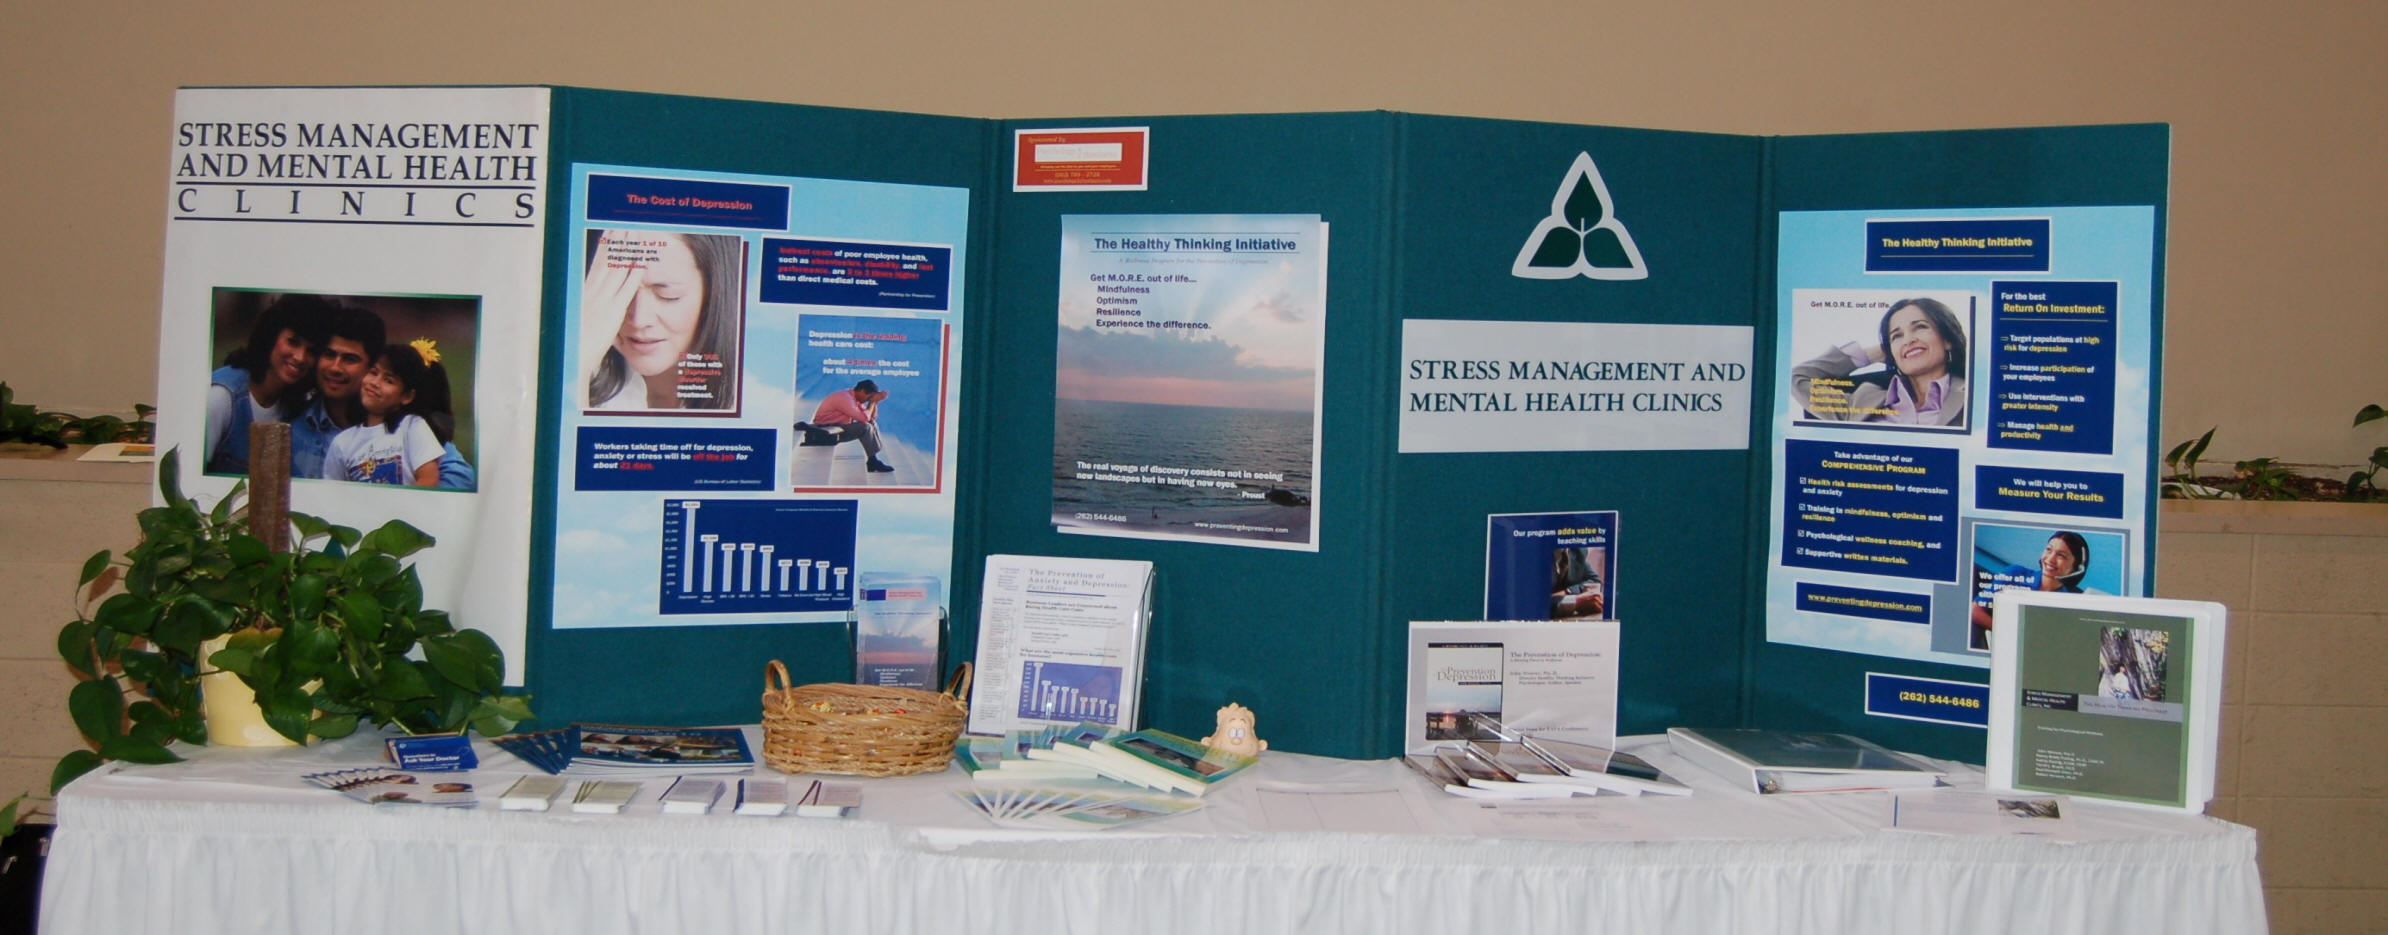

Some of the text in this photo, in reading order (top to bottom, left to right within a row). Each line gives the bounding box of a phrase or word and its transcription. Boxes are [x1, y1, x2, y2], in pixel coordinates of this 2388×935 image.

[178, 122, 539, 149] STRESS MANAGEMENT
[176, 153, 537, 181] AND MENTAL HEALTH
[177, 188, 534, 219] CLINICS
[626, 193, 752, 211] The Cost of Depression
[625, 240, 641, 248] year
[1094, 238, 1296, 252] The Healthy Thinking Initiative
[1882, 237, 2033, 249] The Healthy Thinking Initiative
[607, 247, 644, 255] Americans
[607, 254, 643, 263] diagnosed
[778, 274, 796, 282] than
[797, 275, 821, 284] direct
[822, 277, 854, 285] medical
[1090, 274, 1106, 282] Get
[1107, 274, 1145, 283] M.O.R.E.
[1146, 275, 1162, 283] out
[1164, 274, 1173, 283] of
[1097, 285, 1150, 294] Mindfulness
[1096, 296, 1138, 306] Optimism
[2001, 292, 2046, 301] For the best
[1096, 308, 1141, 317] Resilience
[2003, 303, 2105, 314] Return On Investment:
[1096, 319, 1212, 330] Experience the difference.
[2029, 345, 2068, 353] depression
[686, 353, 703, 361] Only
[822, 367, 920, 377] for the average employee
[1409, 359, 1746, 382] STRESS MANAGEMENT AND
[2009, 364, 2095, 374] Increase participation of
[2018, 374, 2056, 383] employees
[1409, 392, 1723, 412] MENTAL HEALTH CLINICS
[2008, 392, 2085, 403] Use interventions with
[594, 443, 629, 451] Workers
[630, 443, 658, 452] taking
[706, 444, 754, 452] depression,
[1834, 451, 1851, 459] Take
[1852, 452, 1890, 462] advantage
[1891, 454, 1900, 462] of
[1076, 461, 1284, 482] The real voyage of discovery consists not in seeing
[1886, 464, 1926, 475] PROGRAM
[1076, 472, 1238, 490] new landscapes but in having new eyes.
[1807, 478, 1831, 487] Health
[1907, 485, 1948, 495] depression
[2013, 478, 2088, 490] We will help you to
[1241, 490, 1265, 500] Proust
[1817, 488, 1843, 497] anxiety
[1998, 487, 2105, 503] Measure Your Results
[1807, 504, 1835, 514] Training
[1836, 506, 1843, 514] in
[1892, 511, 1927, 521] optimism
[1927, 514, 1943, 522] and
[1513, 529, 1526, 537] Our
[1527, 529, 1556, 538] program
[1577, 527, 1597, 535] value
[1598, 527, 1606, 535] by
[1557, 535, 1606, 545] teaching skills
[1048, 570, 1093, 578] Prevention
[1978, 571, 2036, 584] We offer all of
[1808, 593, 1923, 613] www.preventingdepression.com
[1437, 671, 1496, 683] Depression
[1899, 690, 1980, 709] (262) 544-6486
